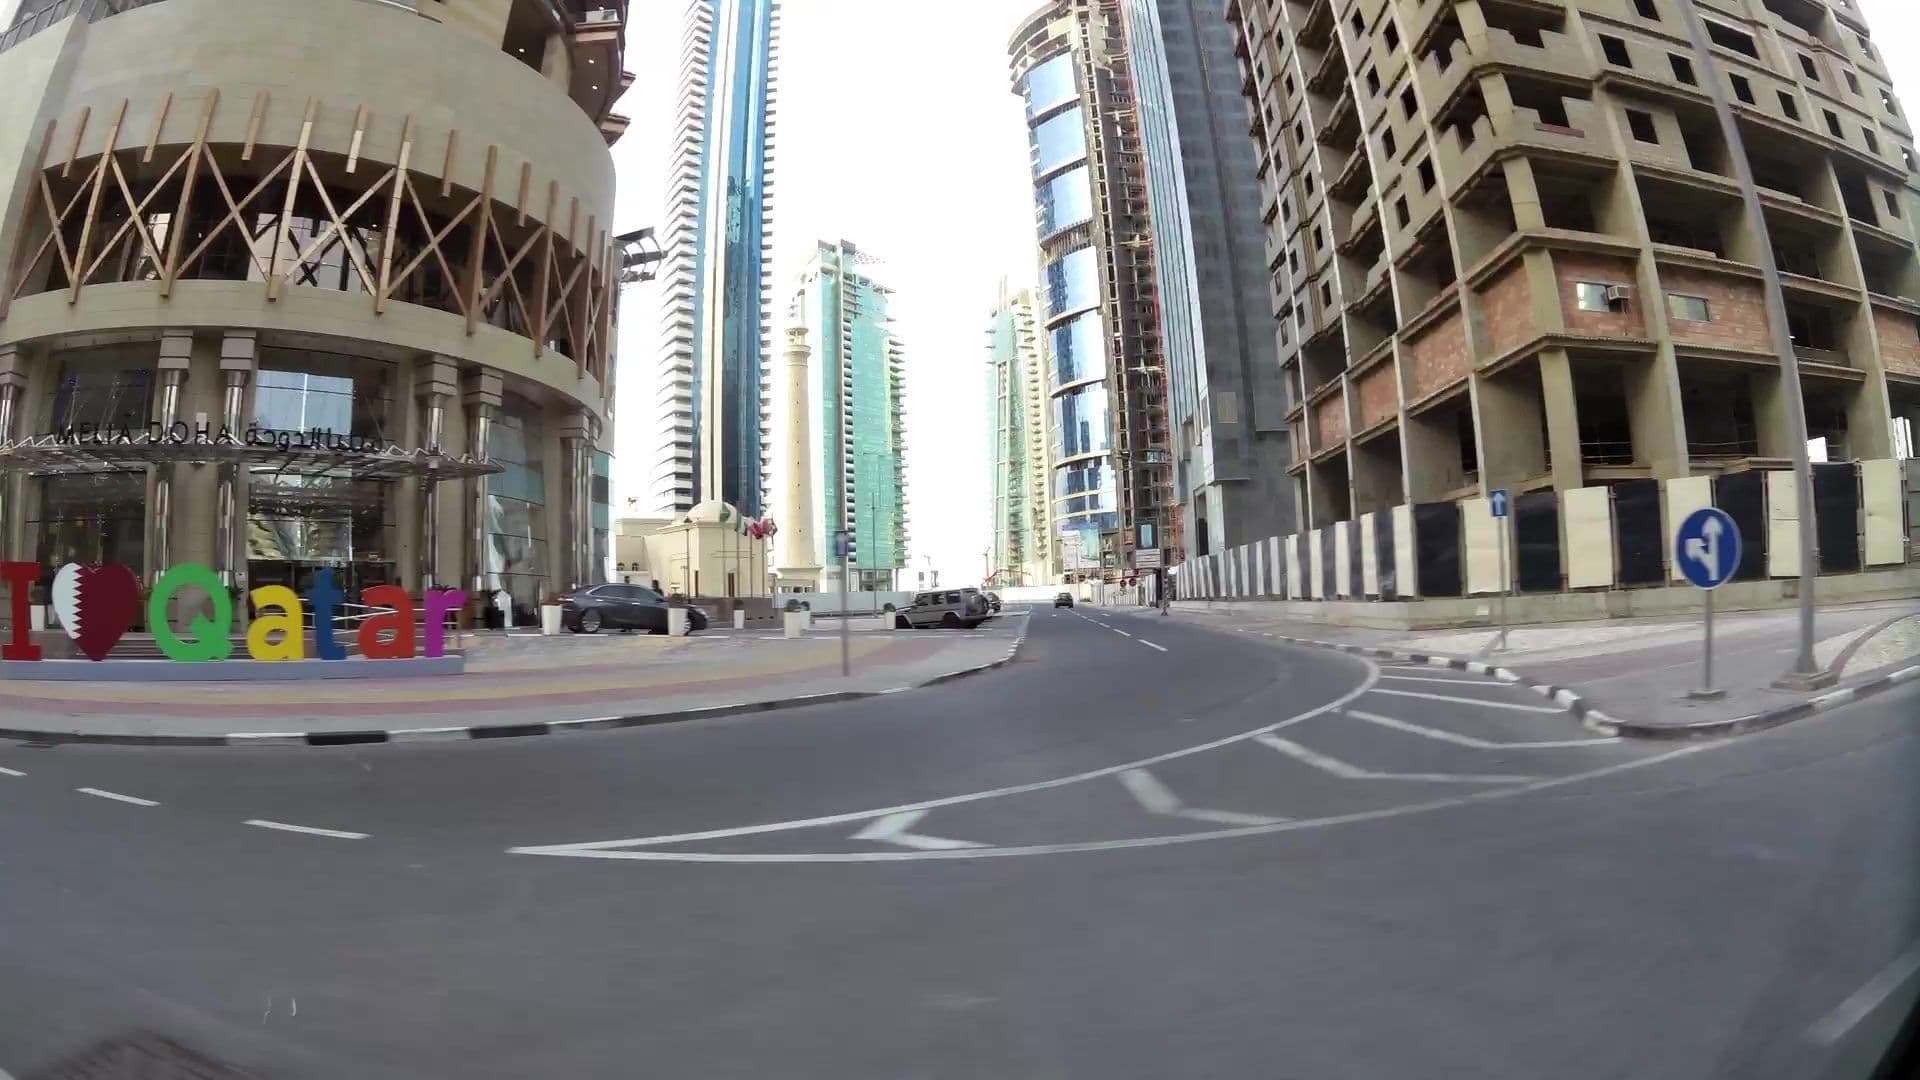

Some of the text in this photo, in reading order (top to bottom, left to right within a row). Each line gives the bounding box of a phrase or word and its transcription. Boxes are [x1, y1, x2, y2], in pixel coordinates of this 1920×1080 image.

[148, 420, 235, 445] DOHA
[0, 561, 467, 662] I Qatar
